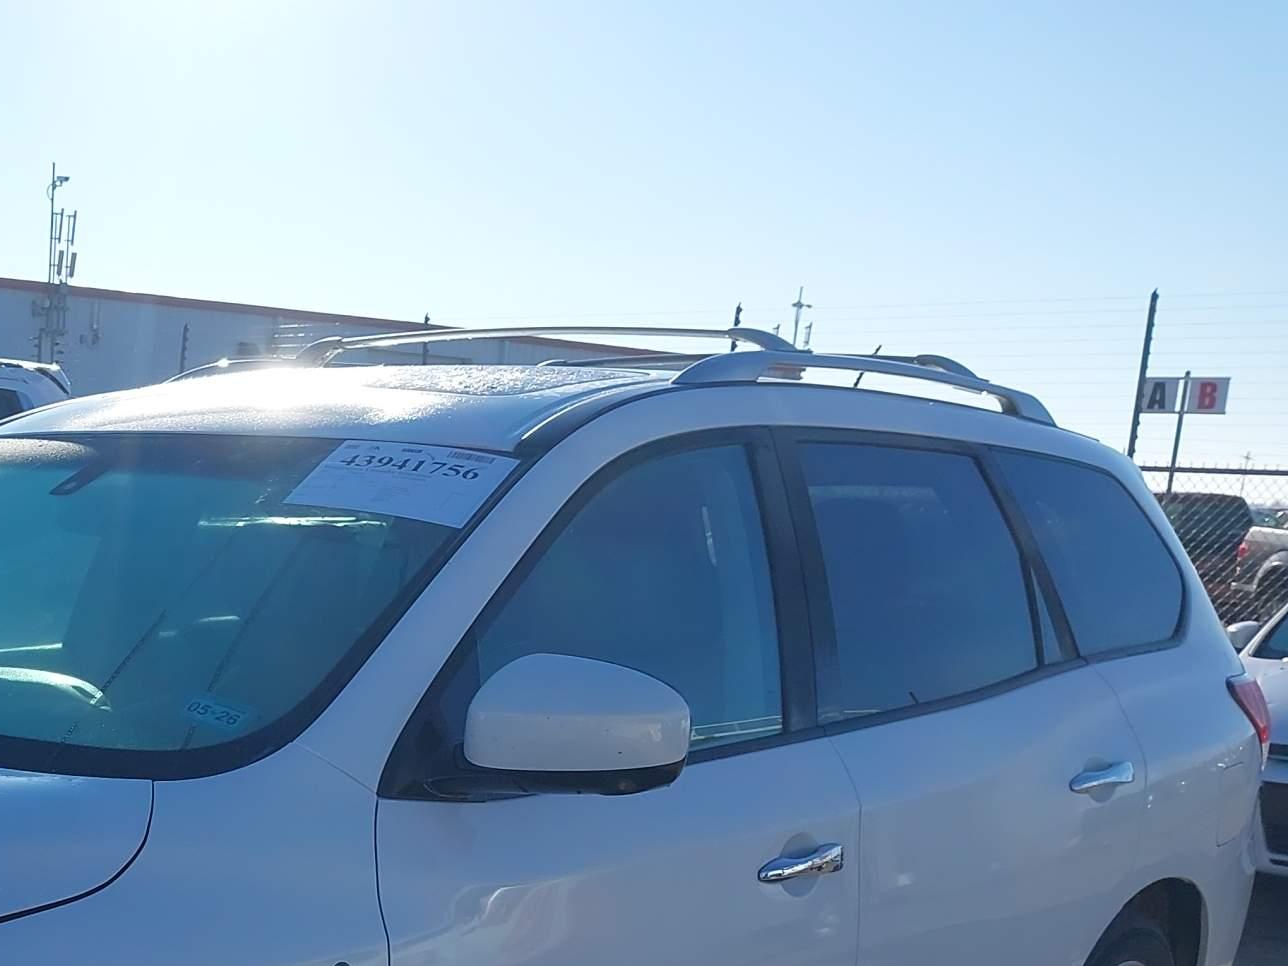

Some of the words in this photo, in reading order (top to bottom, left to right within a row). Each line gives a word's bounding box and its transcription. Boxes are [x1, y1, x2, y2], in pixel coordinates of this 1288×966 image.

[1146, 381, 1167, 410] A
[1197, 381, 1218, 410] B
[339, 454, 480, 480] 43941756
